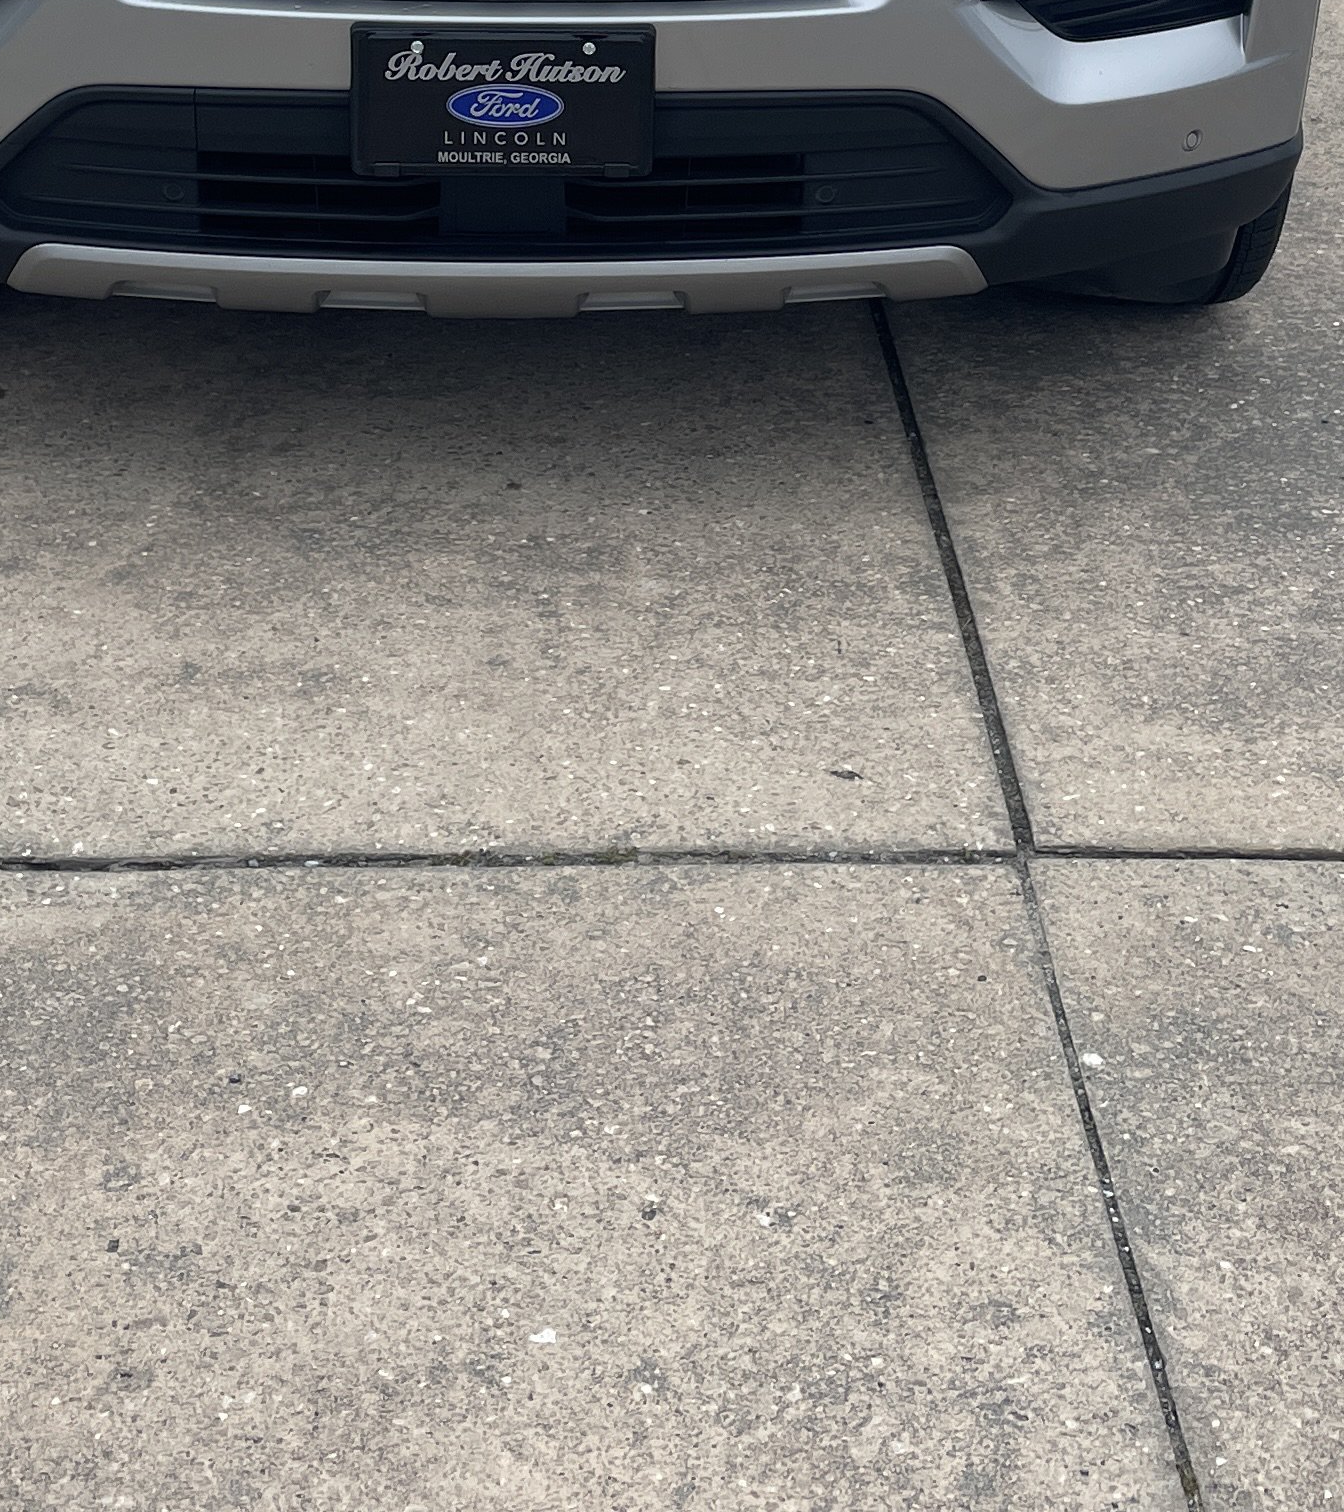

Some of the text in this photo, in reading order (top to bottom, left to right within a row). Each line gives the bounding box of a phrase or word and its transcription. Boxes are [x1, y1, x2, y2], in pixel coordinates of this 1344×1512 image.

[384, 50, 626, 83] Robert Hutson
[469, 90, 540, 119] Ford
[444, 130, 567, 146] LINCOLN
[437, 151, 571, 165] MOULTRIE, GEORGIA
